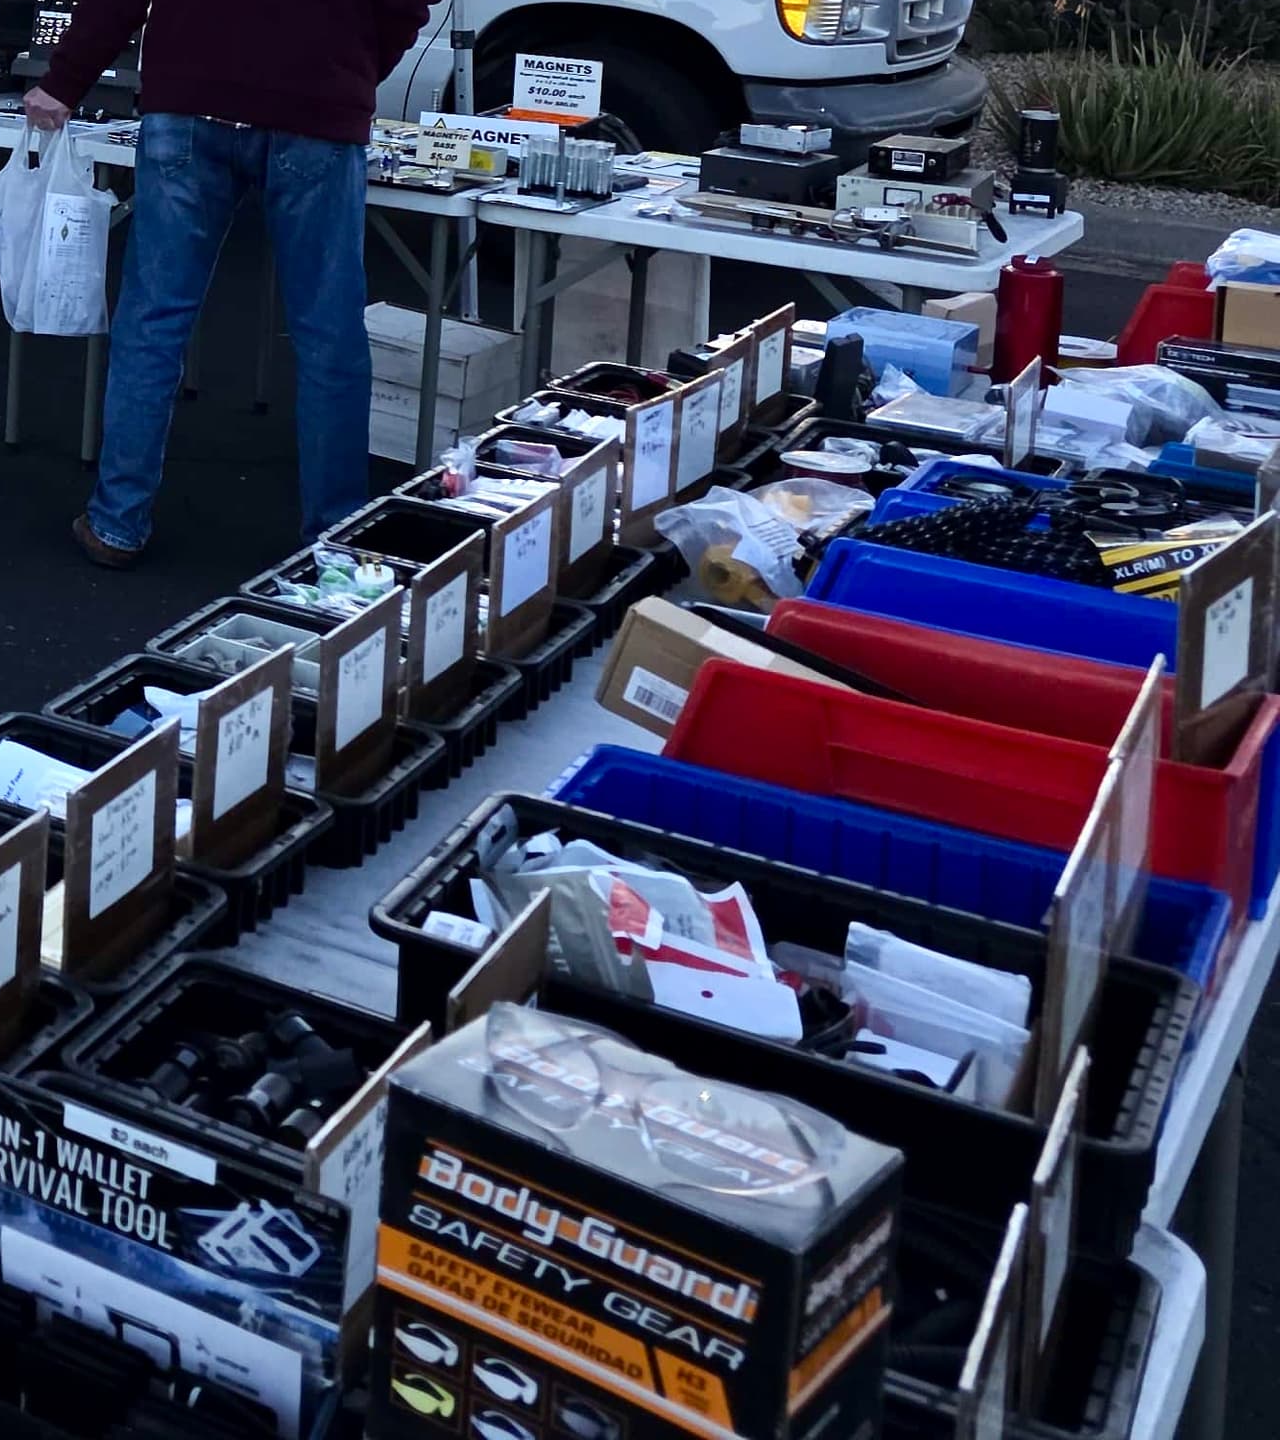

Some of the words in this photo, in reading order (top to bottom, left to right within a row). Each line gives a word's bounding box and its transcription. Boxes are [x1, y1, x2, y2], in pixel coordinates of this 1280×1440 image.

[524, 59, 593, 75] MAGNETS
[528, 86, 566, 97] $10.00
[422, 130, 469, 141] MAGNETIC
[433, 142, 457, 150] BASE
[430, 153, 458, 161] $5.00
[1114, 555, 1166, 580] XLR(M)
[1170, 549, 1194, 564] TO
[1201, 542, 1223, 556] XL
[111, 1127, 129, 1142] $2
[133, 1139, 169, 1161] each
[56, 1136, 152, 1200] WALLET
[98, 1187, 173, 1250] TOOL
[409, 1204, 593, 1292] SAFETY
[602, 1289, 746, 1372] GEAR
[409, 1243, 488, 1285] SAFETY
[493, 1281, 597, 1338] EYEWEAR
[407, 1262, 477, 1301] GAFAS
[481, 1293, 512, 1316] DE
[516, 1310, 643, 1380] SEGURIDAD
